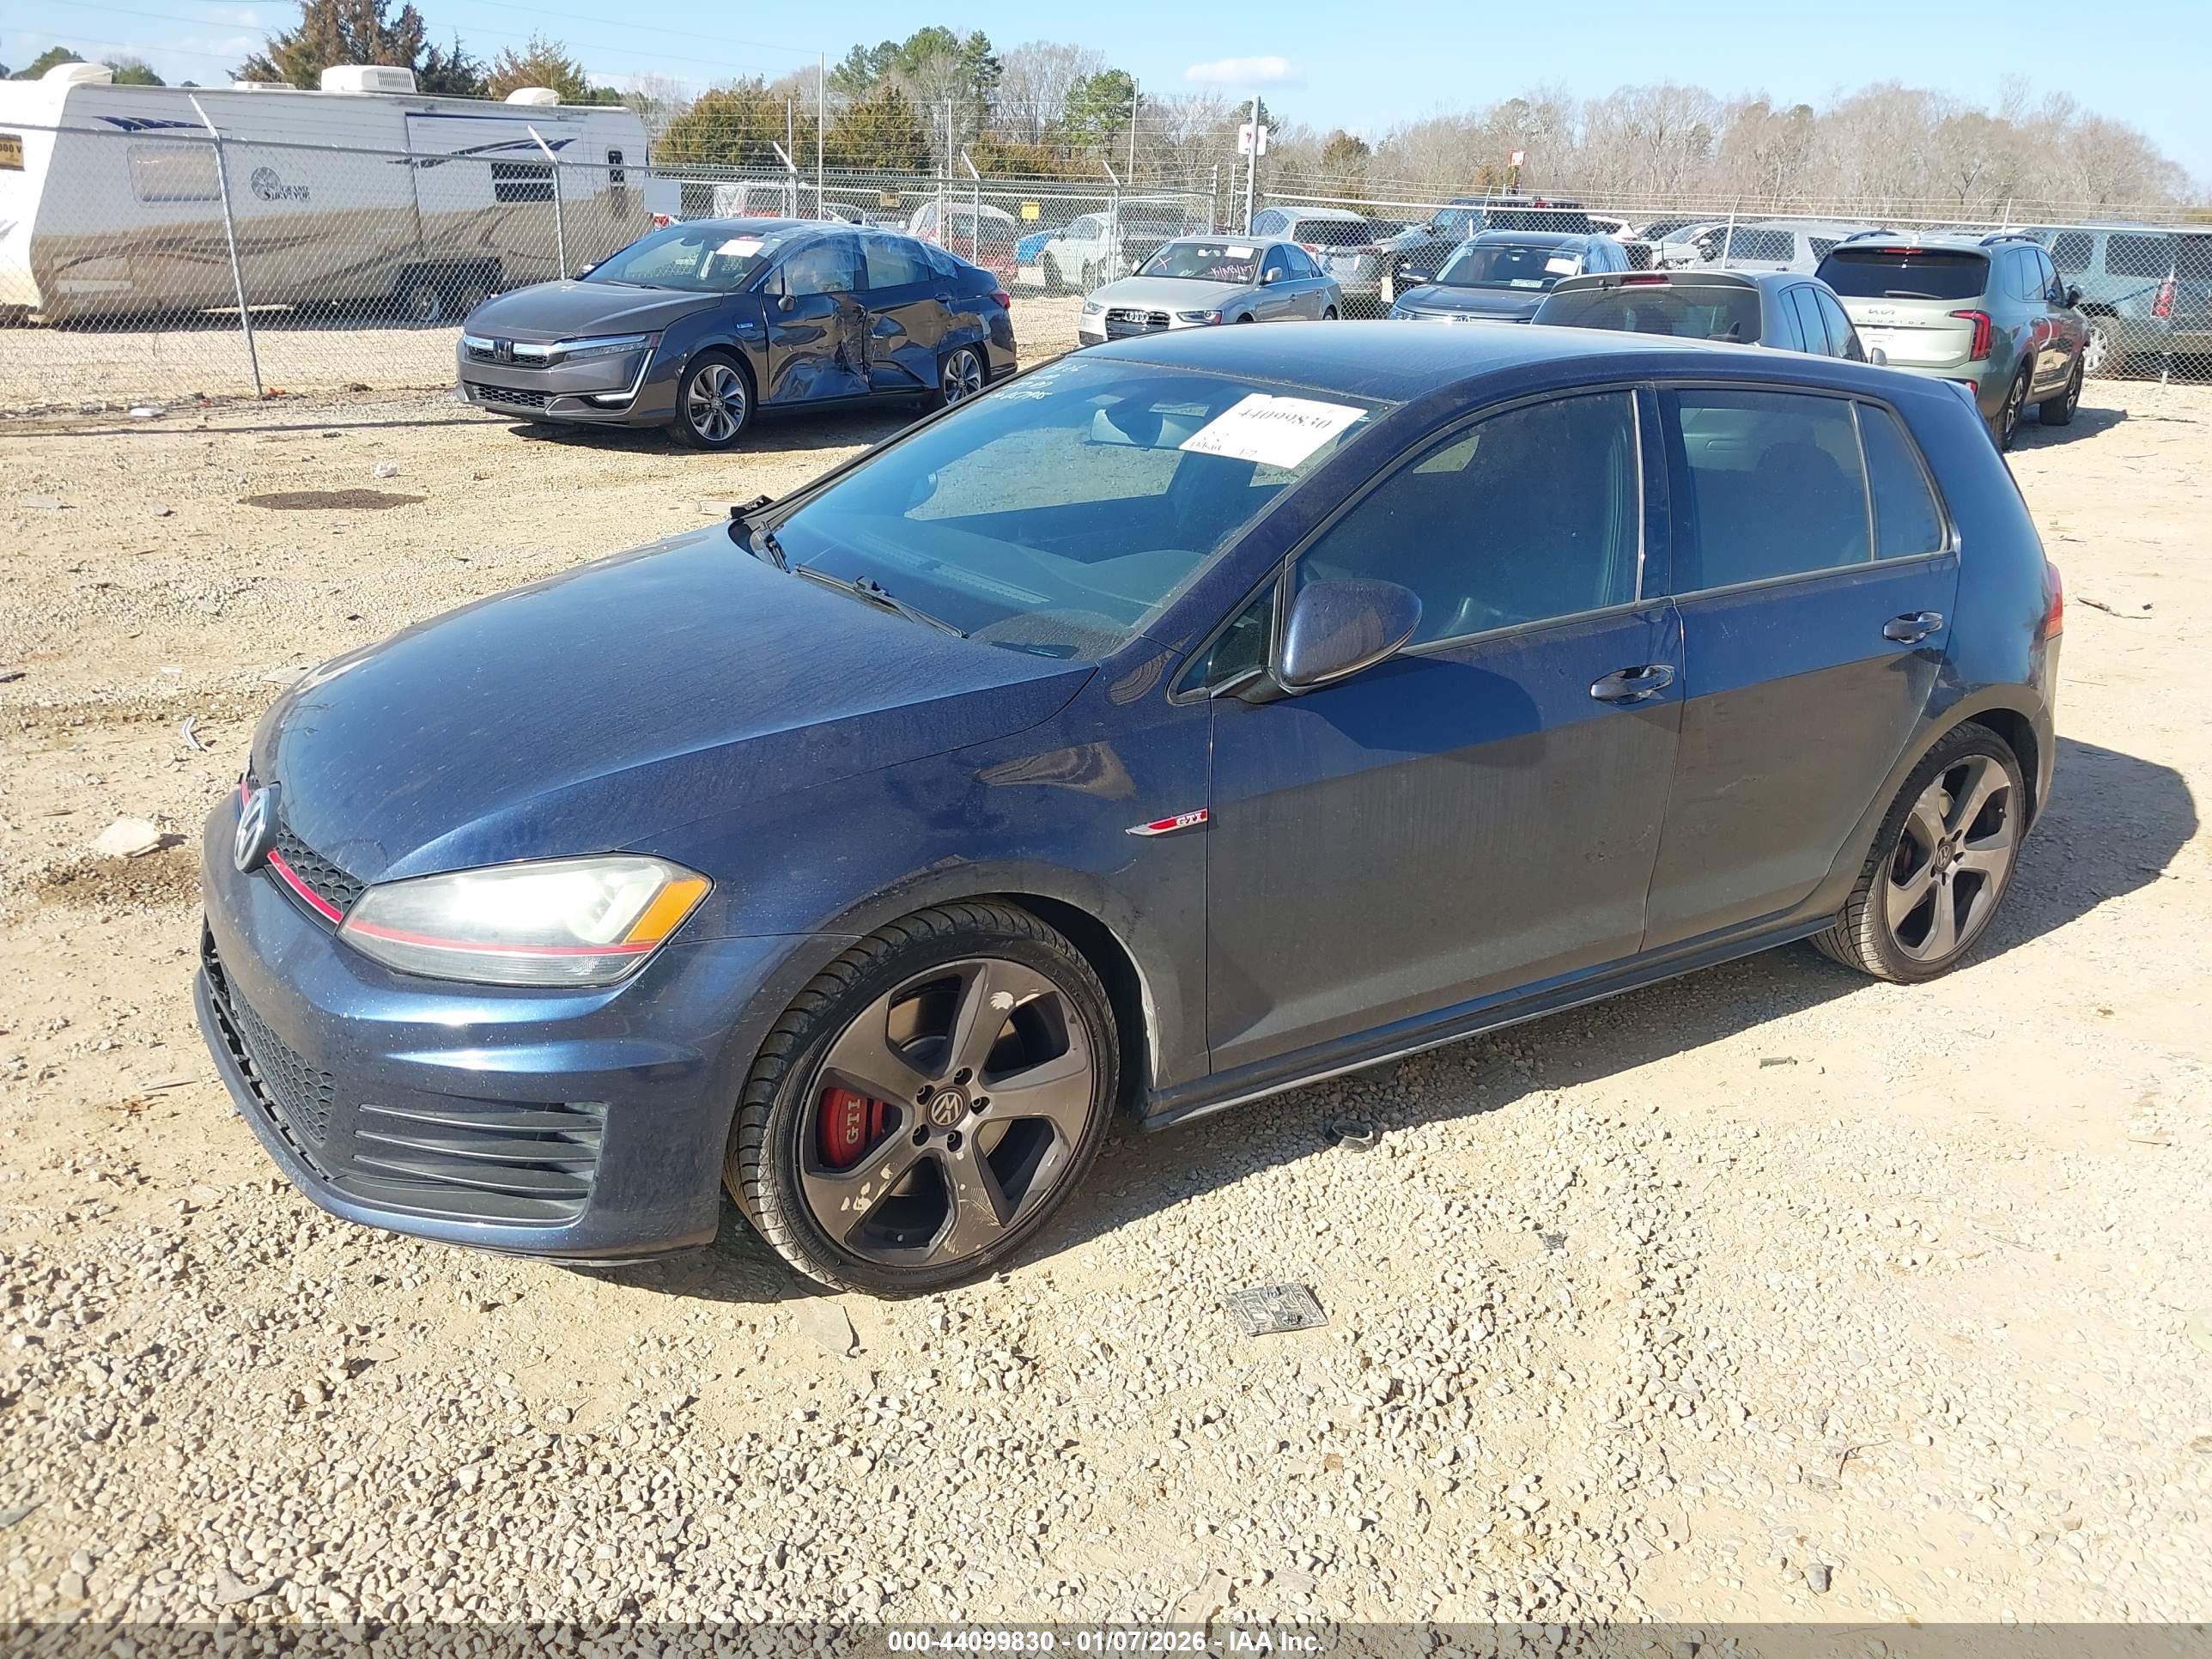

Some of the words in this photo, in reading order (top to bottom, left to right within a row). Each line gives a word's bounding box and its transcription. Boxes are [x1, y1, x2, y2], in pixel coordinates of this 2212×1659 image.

[1238, 408, 1333, 429] 44099830
[1176, 812, 1202, 826] GTI
[845, 1098, 861, 1145] GTI
